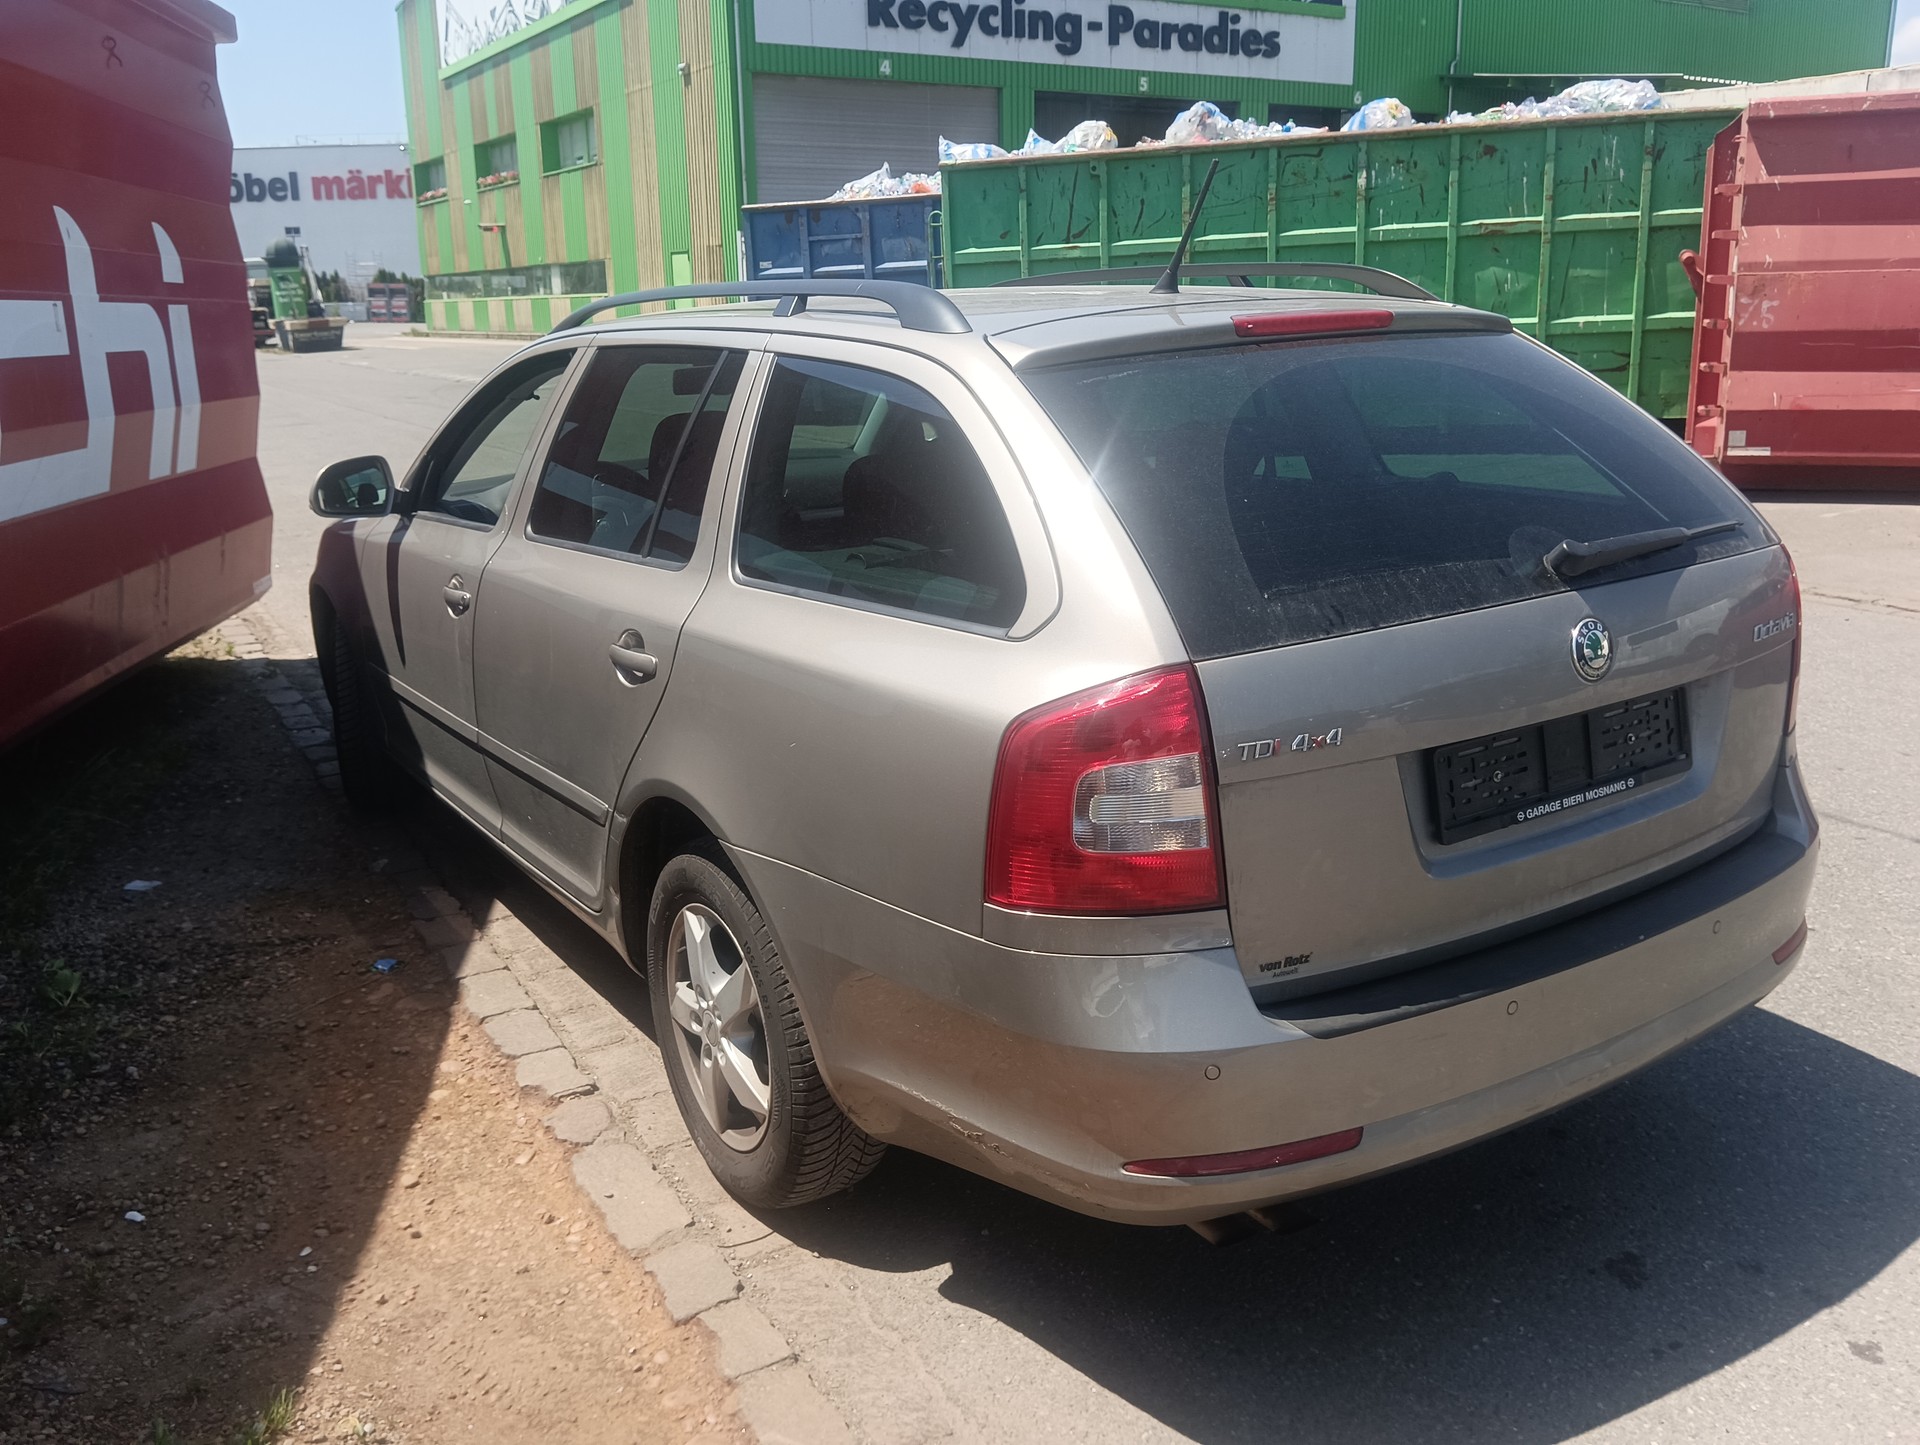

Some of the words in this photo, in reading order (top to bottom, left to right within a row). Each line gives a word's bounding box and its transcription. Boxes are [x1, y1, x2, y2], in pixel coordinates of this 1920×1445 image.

[879, 59, 892, 76] 4
[1139, 77, 1149, 92] 5
[1354, 91, 1361, 104] 6
[1237, 738, 1280, 761] TDI
[1291, 727, 1342, 752] 4x4
[1526, 801, 1562, 819] GARAGE
[1562, 792, 1584, 808] BIERI
[1585, 781, 1626, 801] MOSNANG
[1259, 960, 1282, 972] von
[1283, 953, 1310, 968] Rotz
